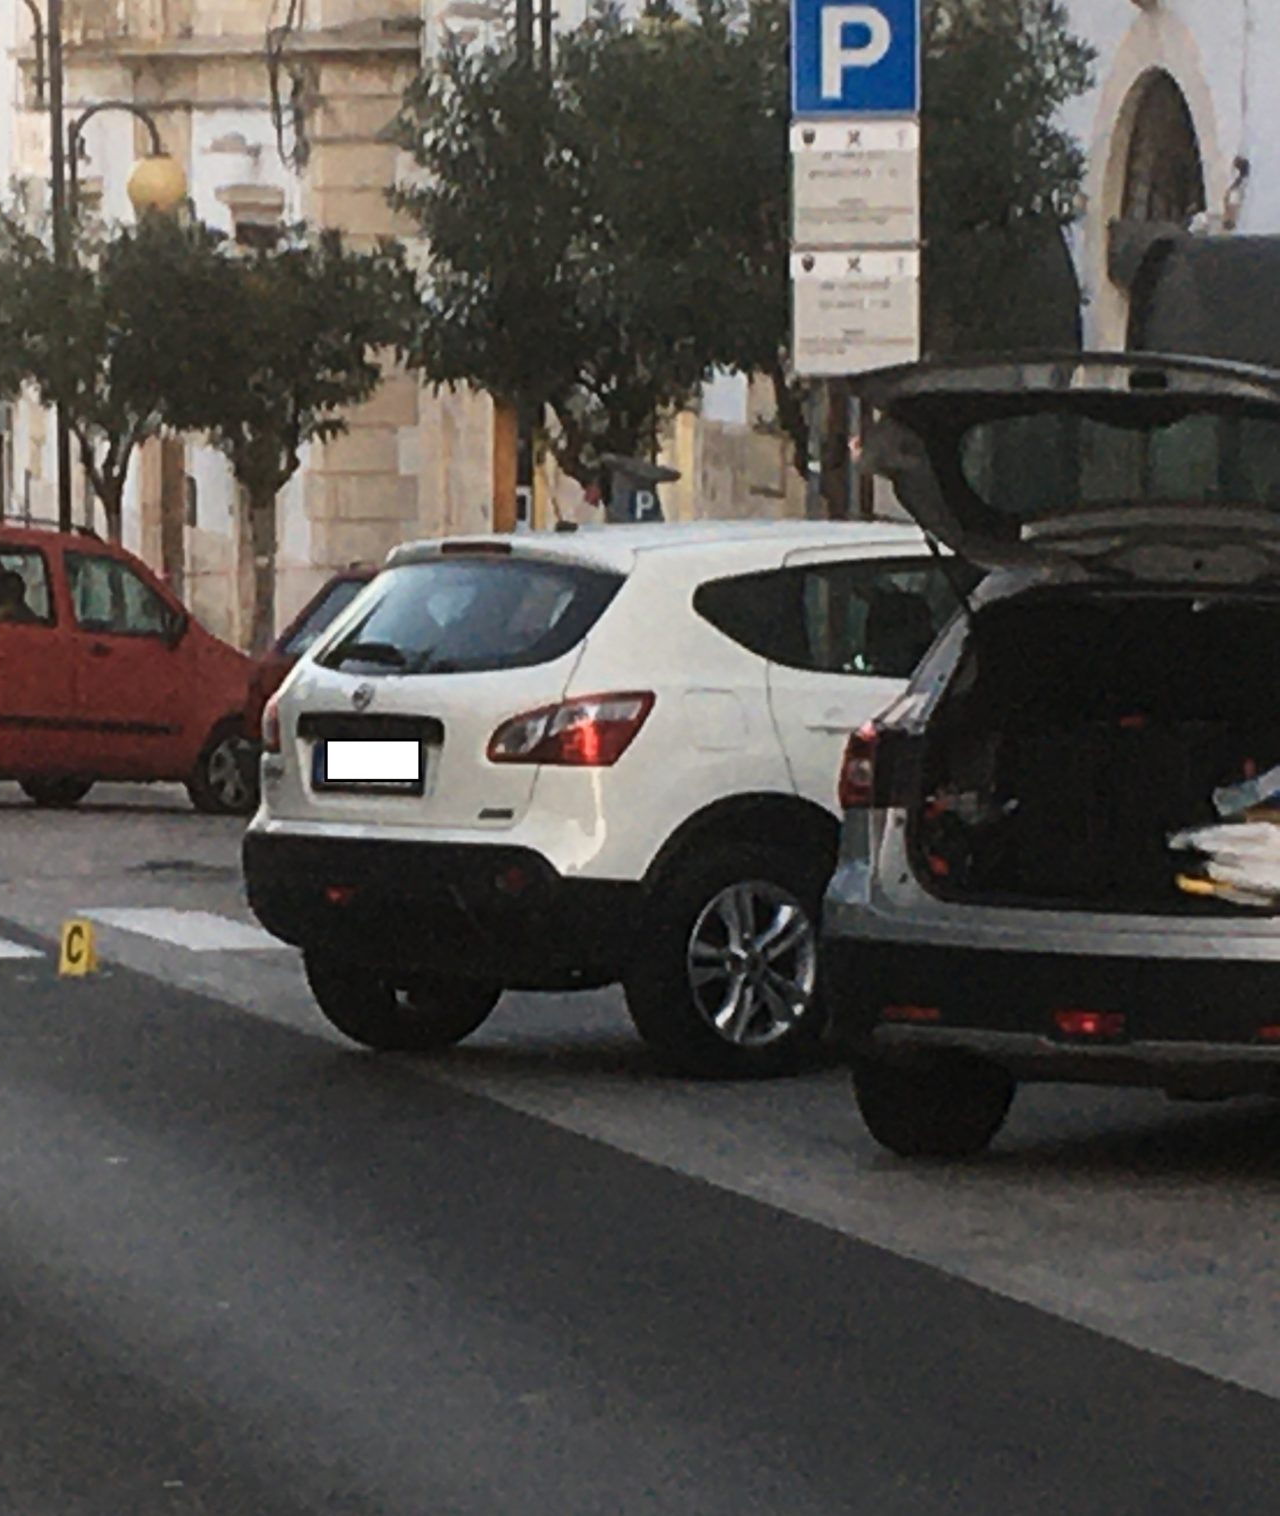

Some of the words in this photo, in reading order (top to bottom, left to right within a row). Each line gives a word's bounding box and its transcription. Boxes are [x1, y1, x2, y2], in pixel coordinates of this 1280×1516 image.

[821, 5, 891, 98] P
[636, 491, 654, 519] P
[66, 925, 83, 964] C
